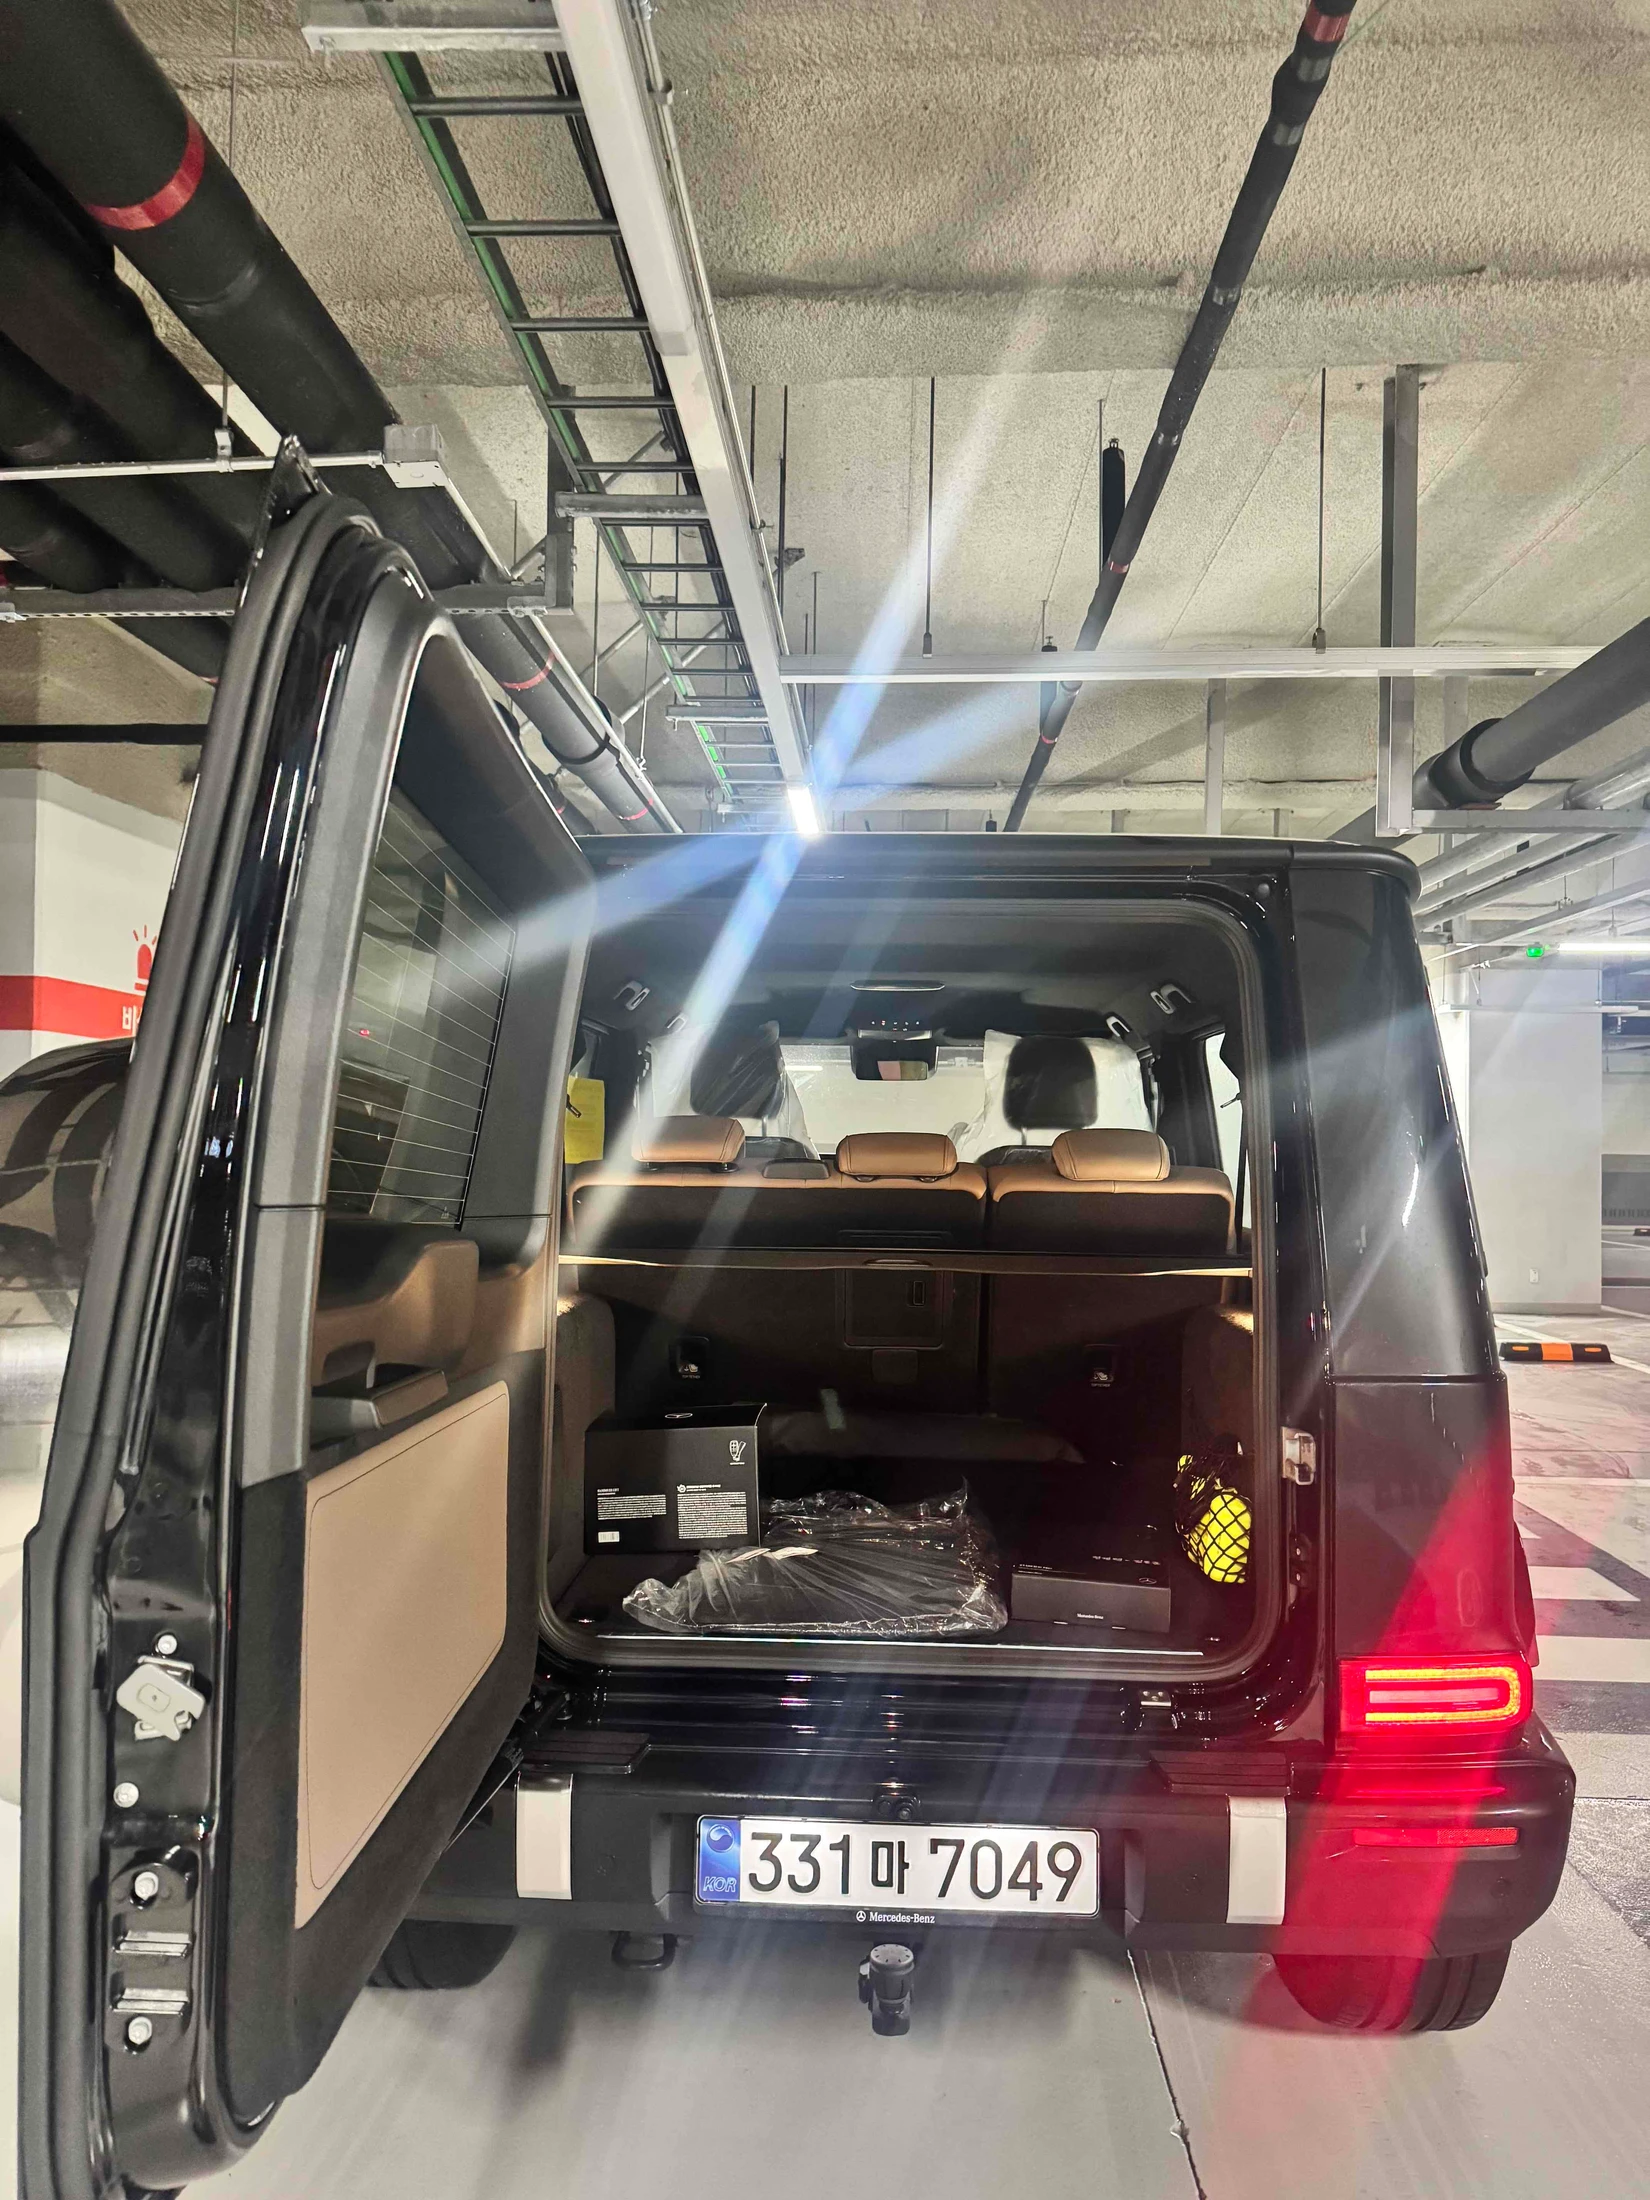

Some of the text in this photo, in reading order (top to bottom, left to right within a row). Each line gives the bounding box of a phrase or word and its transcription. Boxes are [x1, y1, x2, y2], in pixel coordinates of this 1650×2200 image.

[929, 1838, 1082, 1902] 7049
[702, 1876, 737, 1893] KOR
[869, 1911, 936, 1924] Mercedes-Benz
